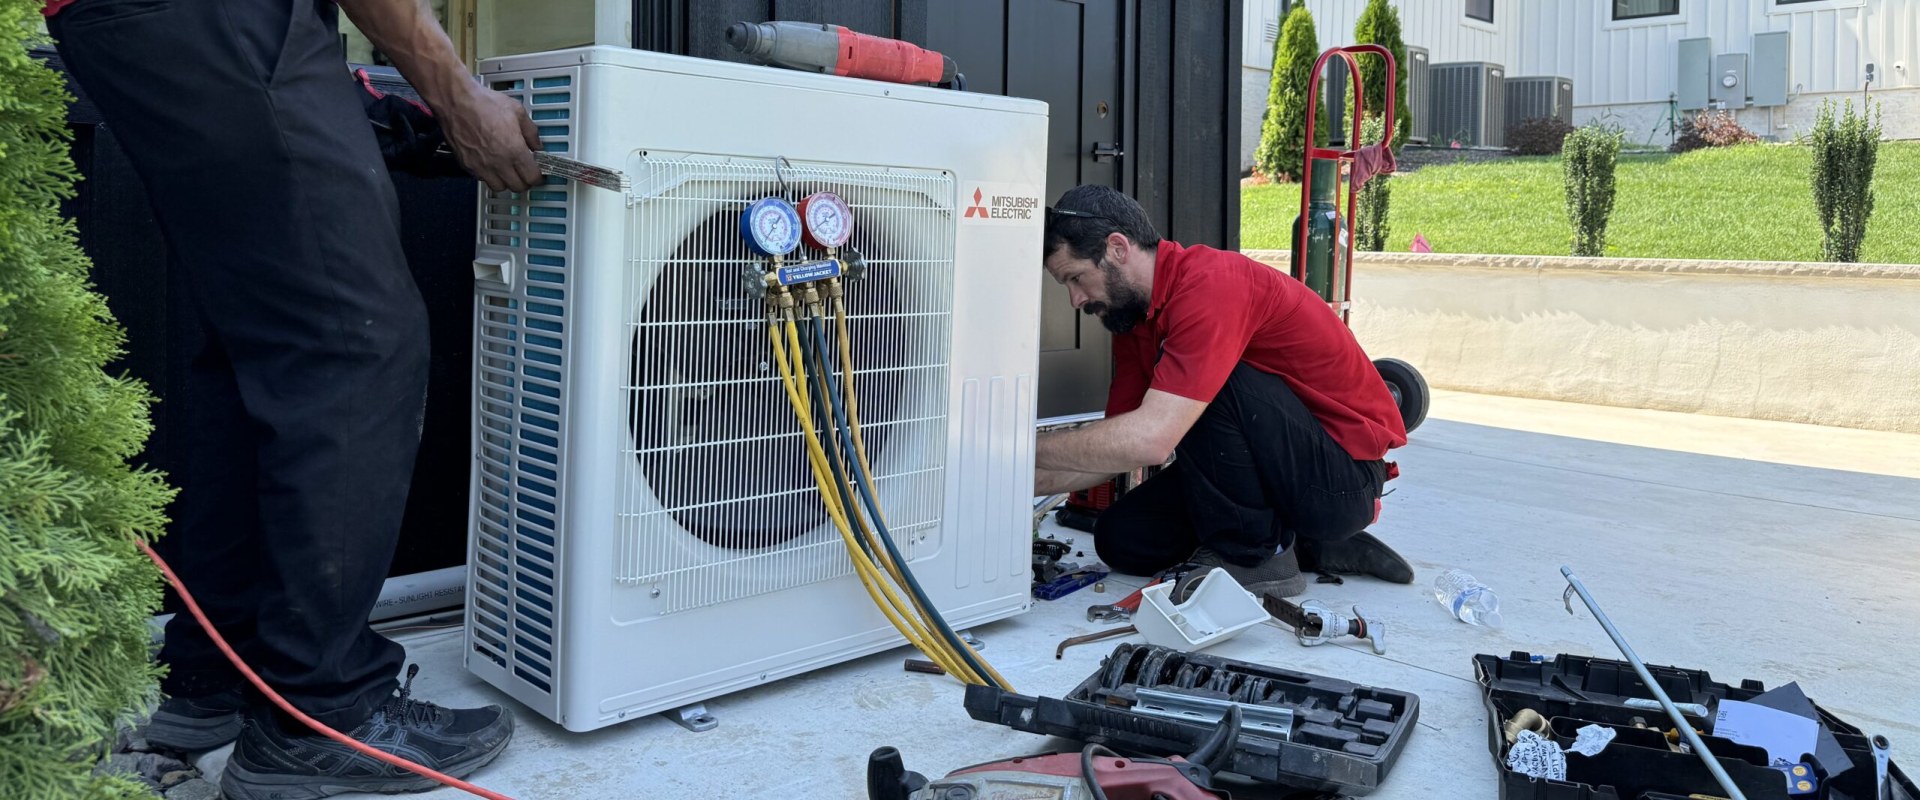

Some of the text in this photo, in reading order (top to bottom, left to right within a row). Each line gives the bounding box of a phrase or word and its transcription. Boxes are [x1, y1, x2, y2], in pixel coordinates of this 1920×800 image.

[992, 196, 1038, 208] MITSUBISHI
[991, 208, 1031, 219] ELECTRIC
[814, 269, 832, 277] JACKET
[399, 591, 433, 604] SUNLIGHT
